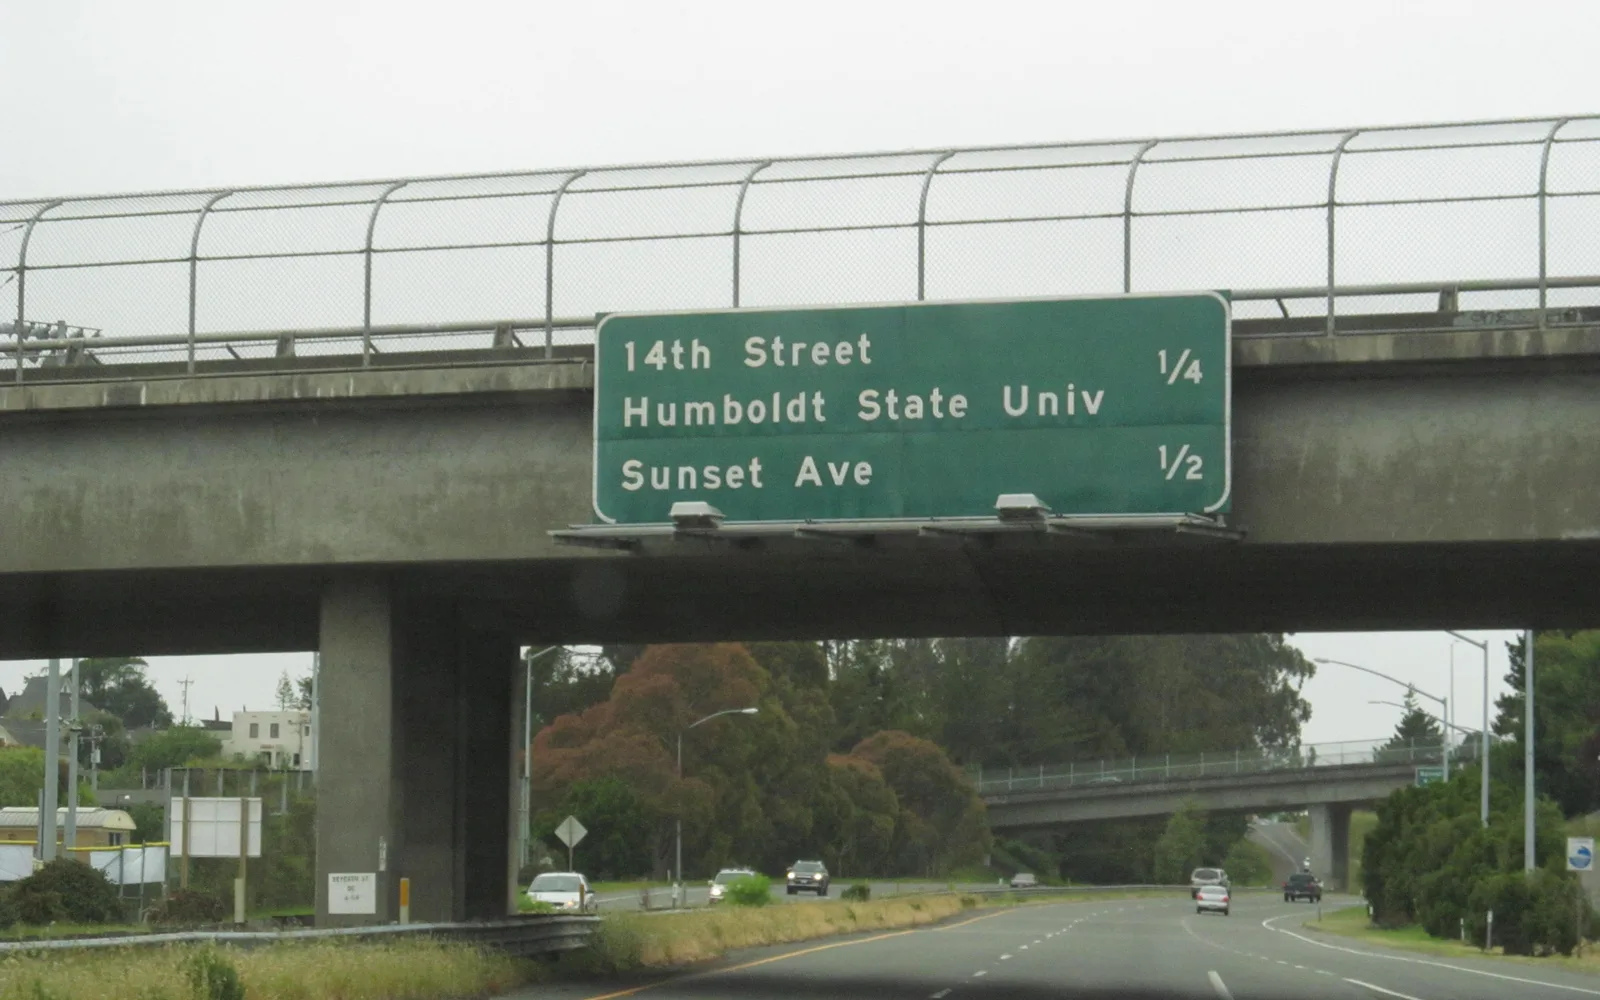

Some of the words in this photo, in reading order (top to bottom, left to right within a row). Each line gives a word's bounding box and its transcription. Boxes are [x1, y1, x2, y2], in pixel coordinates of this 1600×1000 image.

[624, 338, 711, 372] 14th
[743, 333, 872, 368] Street
[624, 389, 826, 427] Humboldt
[857, 387, 968, 421] State
[1003, 383, 1105, 417] Univ
[621, 456, 763, 491] Sunset
[795, 455, 873, 487] Ave
